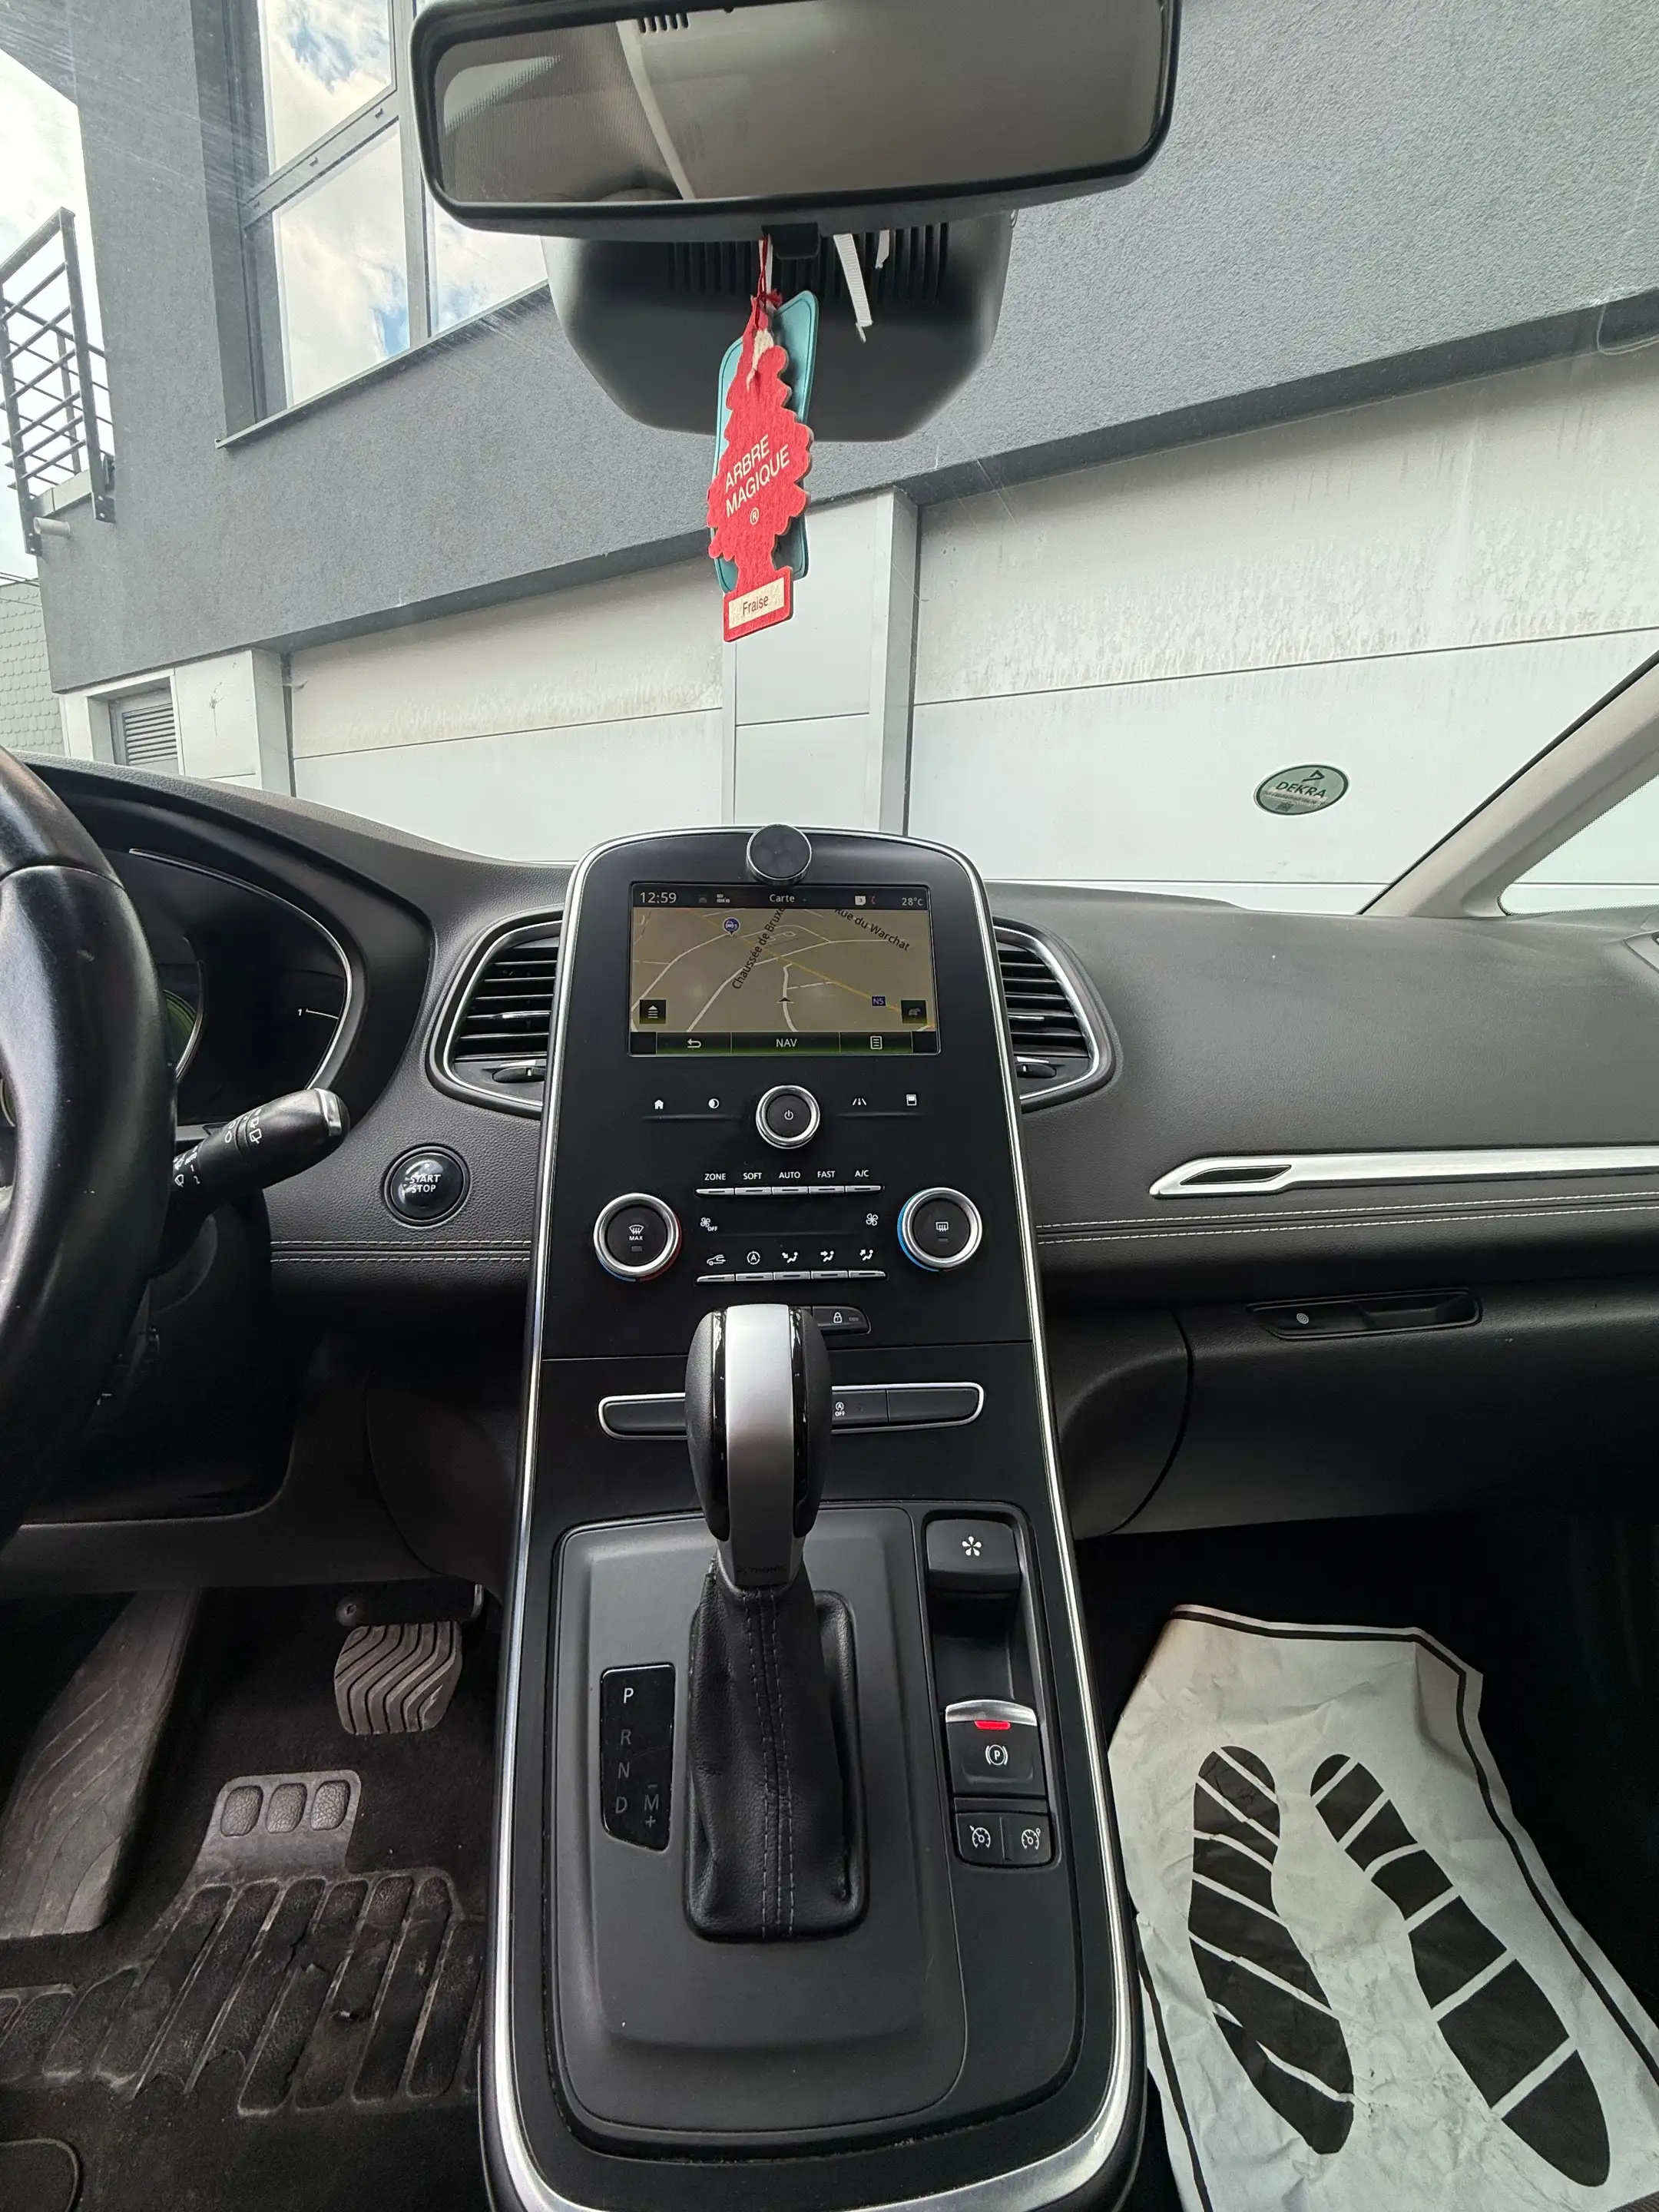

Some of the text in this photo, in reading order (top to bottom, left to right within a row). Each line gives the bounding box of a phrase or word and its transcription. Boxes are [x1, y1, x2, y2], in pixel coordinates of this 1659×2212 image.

[725, 434, 770, 493] ARBRE
[725, 444, 790, 518] MAGIQUE
[743, 595, 769, 616] Fraise
[1275, 781, 1326, 798] DEKRA
[640, 892, 677, 904] 12:59
[770, 893, 796, 903] Carte
[854, 917, 869, 929] du
[870, 923, 910, 951] Warchat
[732, 946, 763, 989] Chaussée
[757, 932, 770, 945] de
[776, 1038, 798, 1048] NAV
[409, 1174, 442, 1184] START
[704, 1173, 727, 1181] ZONE
[411, 1184, 436, 1194] STOP
[623, 1687, 634, 1704] P
[620, 1728, 632, 1746] R
[618, 1761, 630, 1779] N
[615, 1796, 628, 1814] D
[644, 1793, 659, 1810] M
